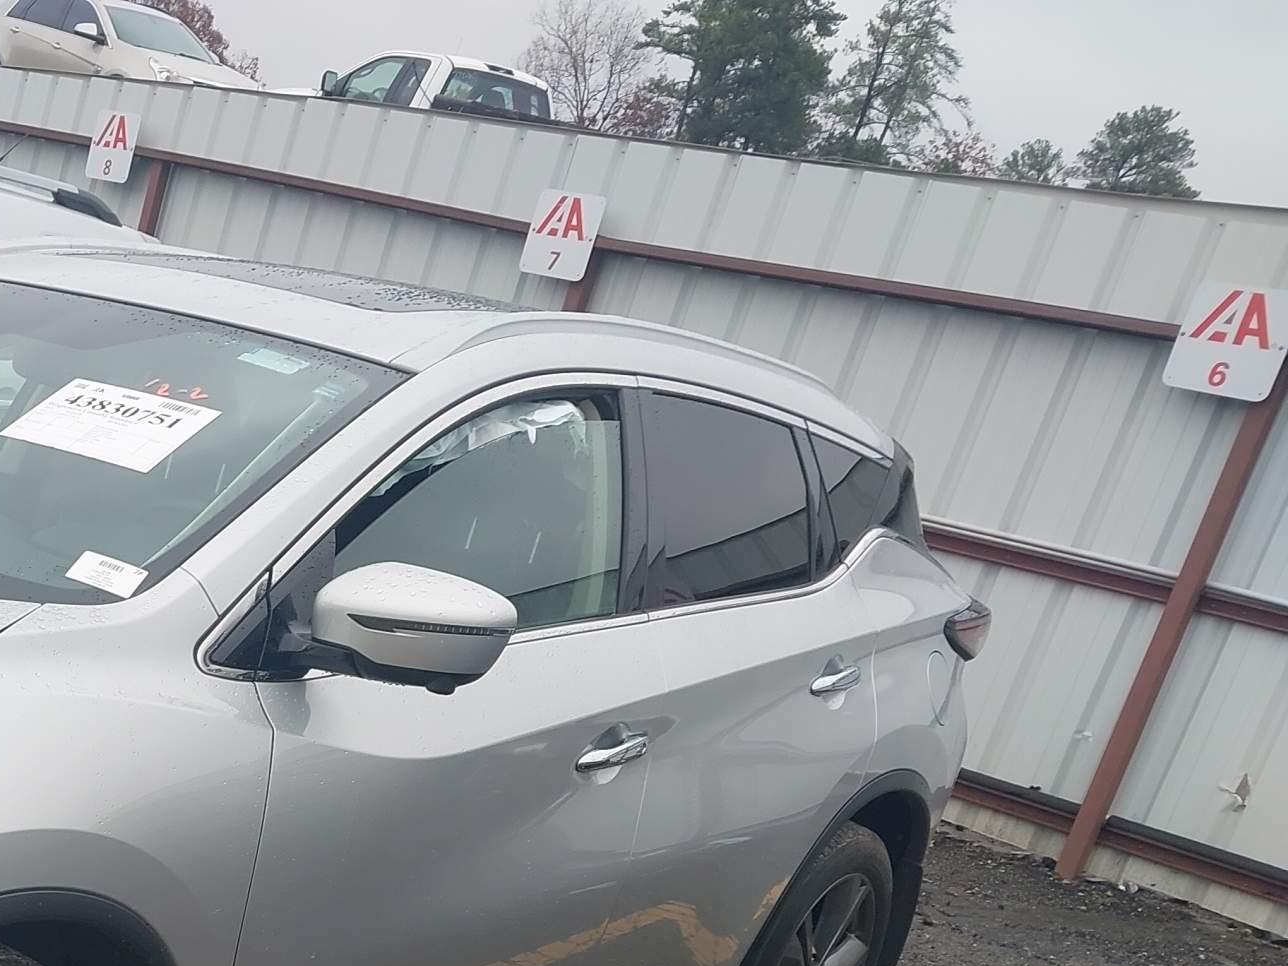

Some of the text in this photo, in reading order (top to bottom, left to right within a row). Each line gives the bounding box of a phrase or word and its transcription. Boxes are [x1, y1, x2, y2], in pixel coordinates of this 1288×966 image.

[103, 159, 112, 176] 8
[547, 251, 561, 271] 7
[1207, 361, 1231, 388] 6
[63, 394, 184, 429] 43830751
